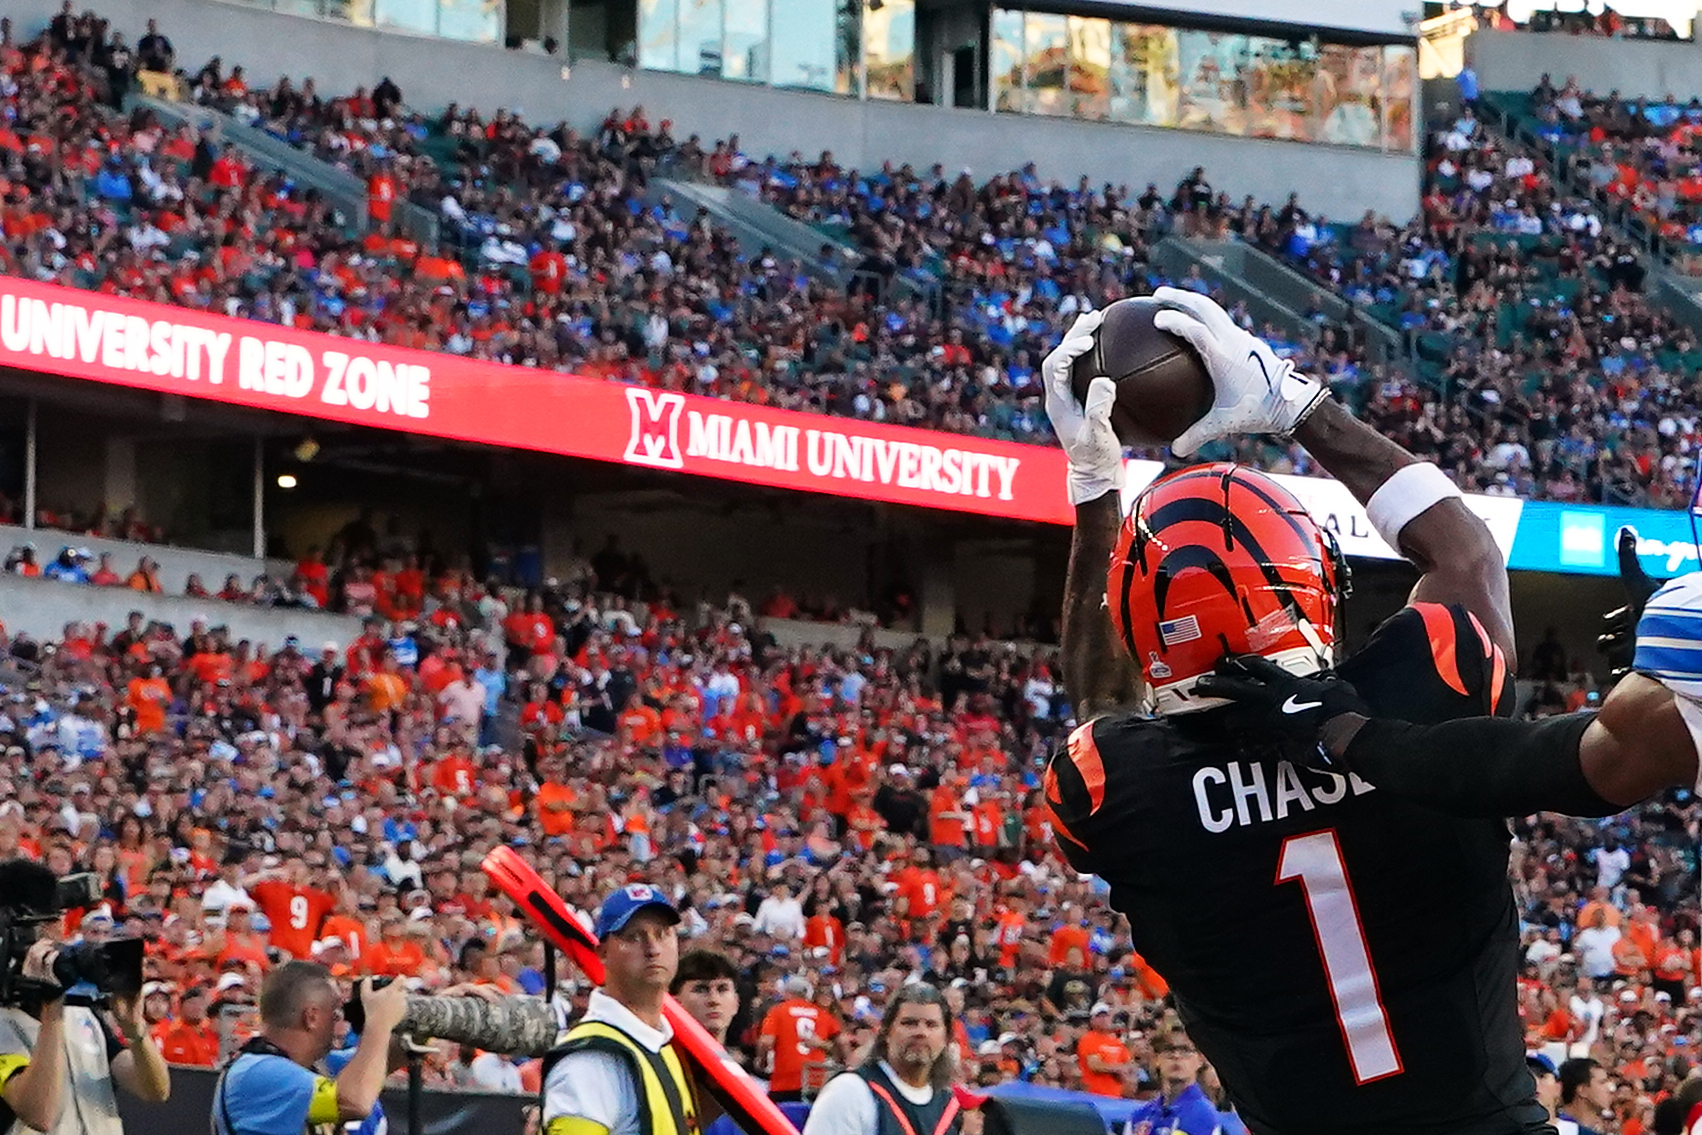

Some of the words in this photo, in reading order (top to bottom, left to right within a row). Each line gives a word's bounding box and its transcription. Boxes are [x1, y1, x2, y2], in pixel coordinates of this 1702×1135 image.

[2, 294, 231, 384] UNIVERSITY
[240, 337, 314, 398] RED
[321, 351, 430, 419] ZONE
[687, 411, 800, 472] MIAMI
[806, 429, 1021, 500] UNIVERSITY
[289, 895, 309, 930] 9
[1273, 827, 1405, 1086] 1
